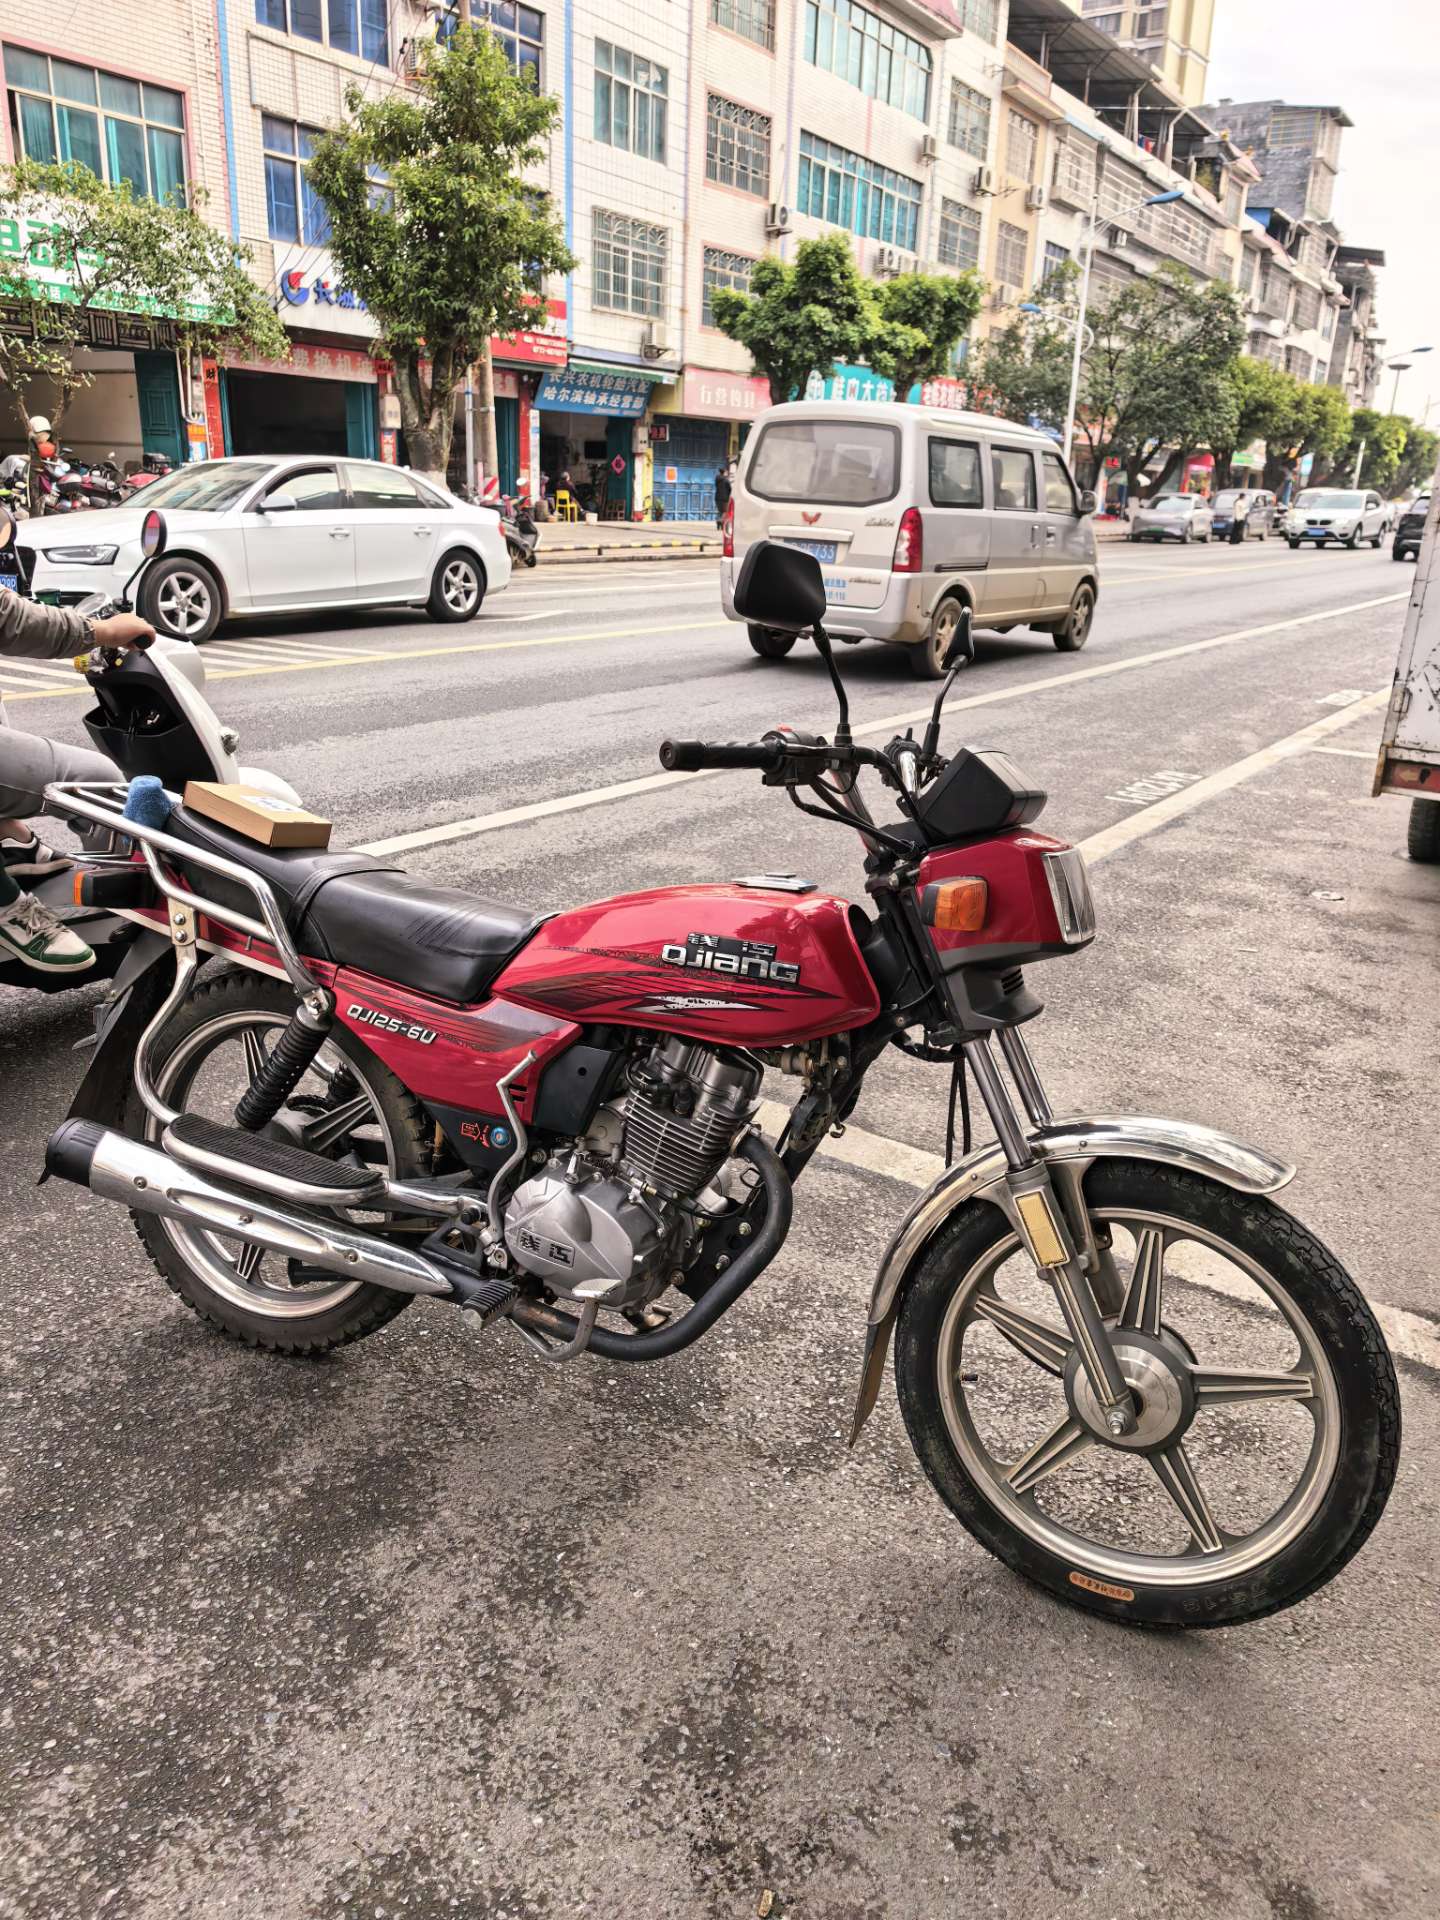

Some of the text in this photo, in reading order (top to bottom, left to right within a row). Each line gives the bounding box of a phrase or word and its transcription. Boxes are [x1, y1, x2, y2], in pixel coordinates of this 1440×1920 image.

[543, 385, 646, 409] 哈尔滨轴承经营部
